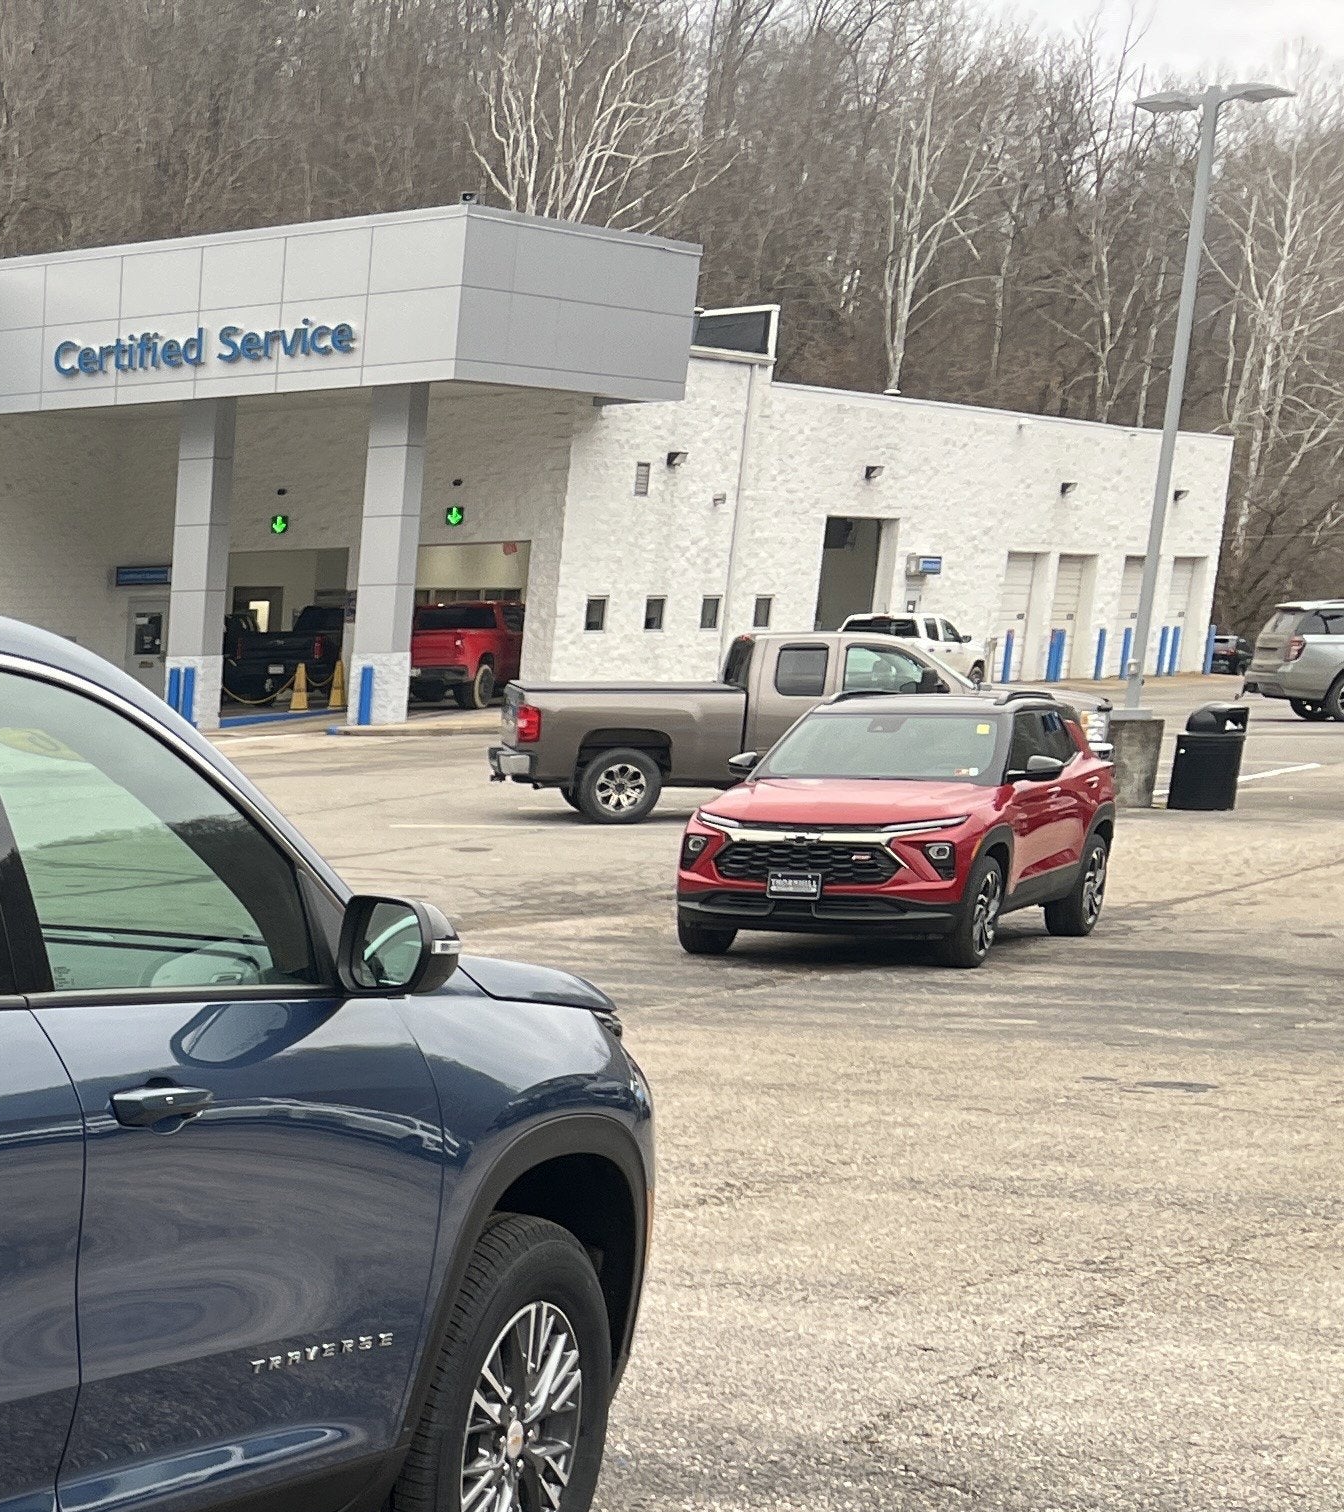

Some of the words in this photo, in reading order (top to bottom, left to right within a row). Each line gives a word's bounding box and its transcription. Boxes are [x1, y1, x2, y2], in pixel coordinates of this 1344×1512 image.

[54, 327, 206, 377] Certified
[217, 318, 357, 364] Service
[249, 1332, 394, 1374] TRAVERSE
